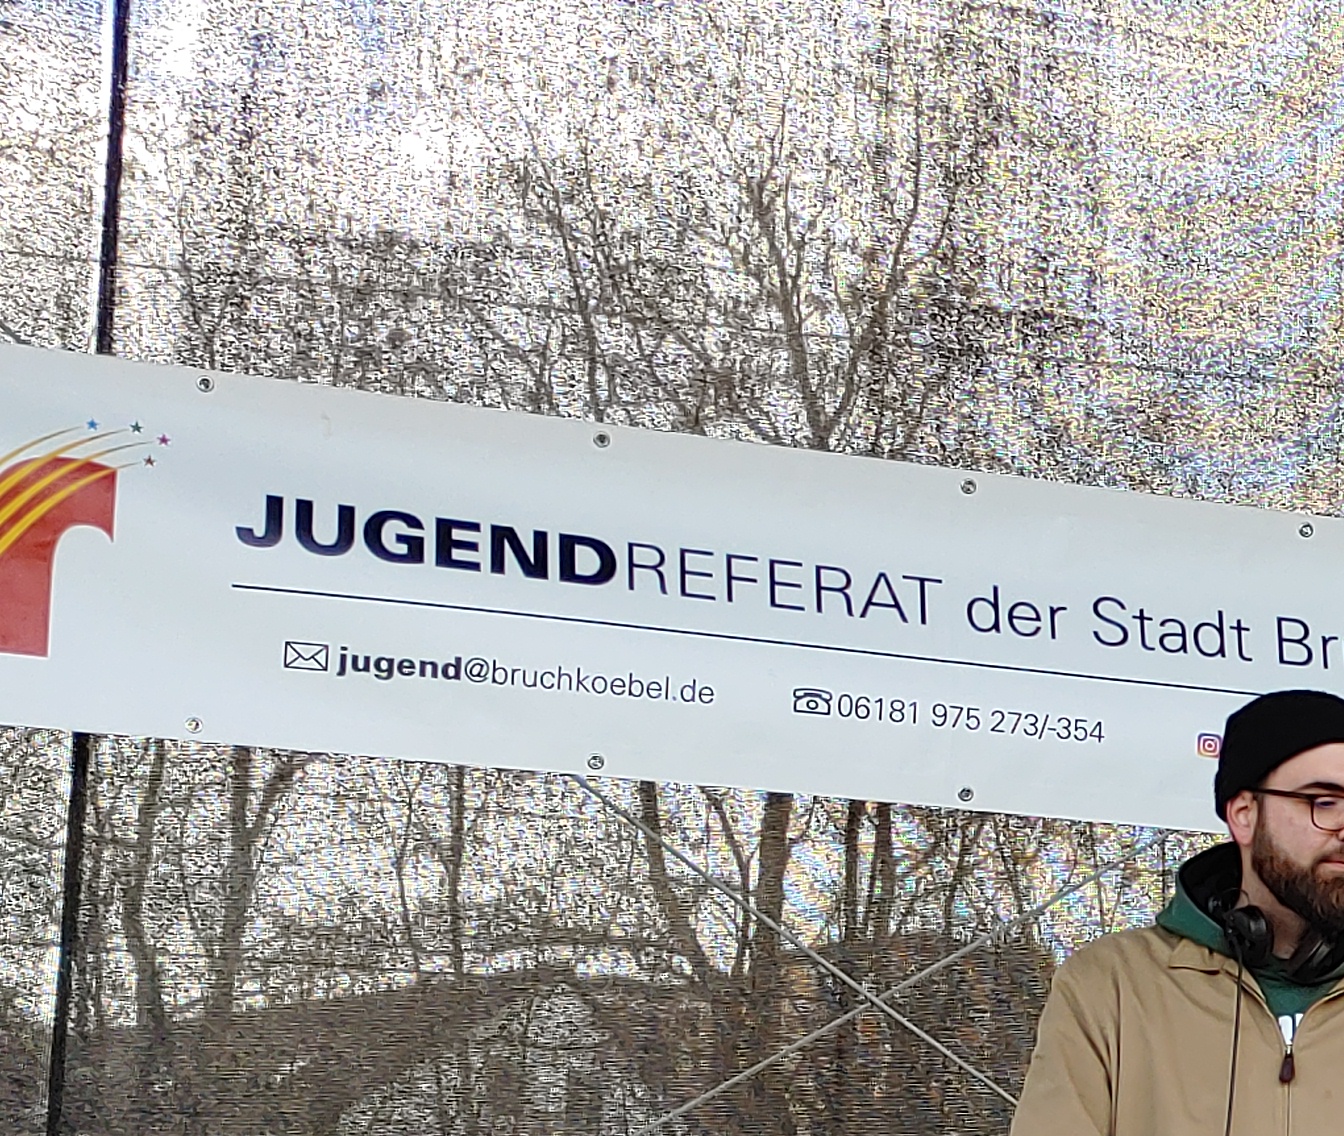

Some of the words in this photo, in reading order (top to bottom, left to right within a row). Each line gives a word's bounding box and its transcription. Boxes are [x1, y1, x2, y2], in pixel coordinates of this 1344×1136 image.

[235, 494, 943, 626] JUGENDREFERAT
[966, 584, 1068, 641] der
[1091, 595, 1254, 662] Stadt
[336, 645, 716, 705] jugend@bruchkoebel.de
[836, 692, 919, 725] 06181
[930, 702, 982, 731] 975
[989, 710, 1106, 744] 273/-354
